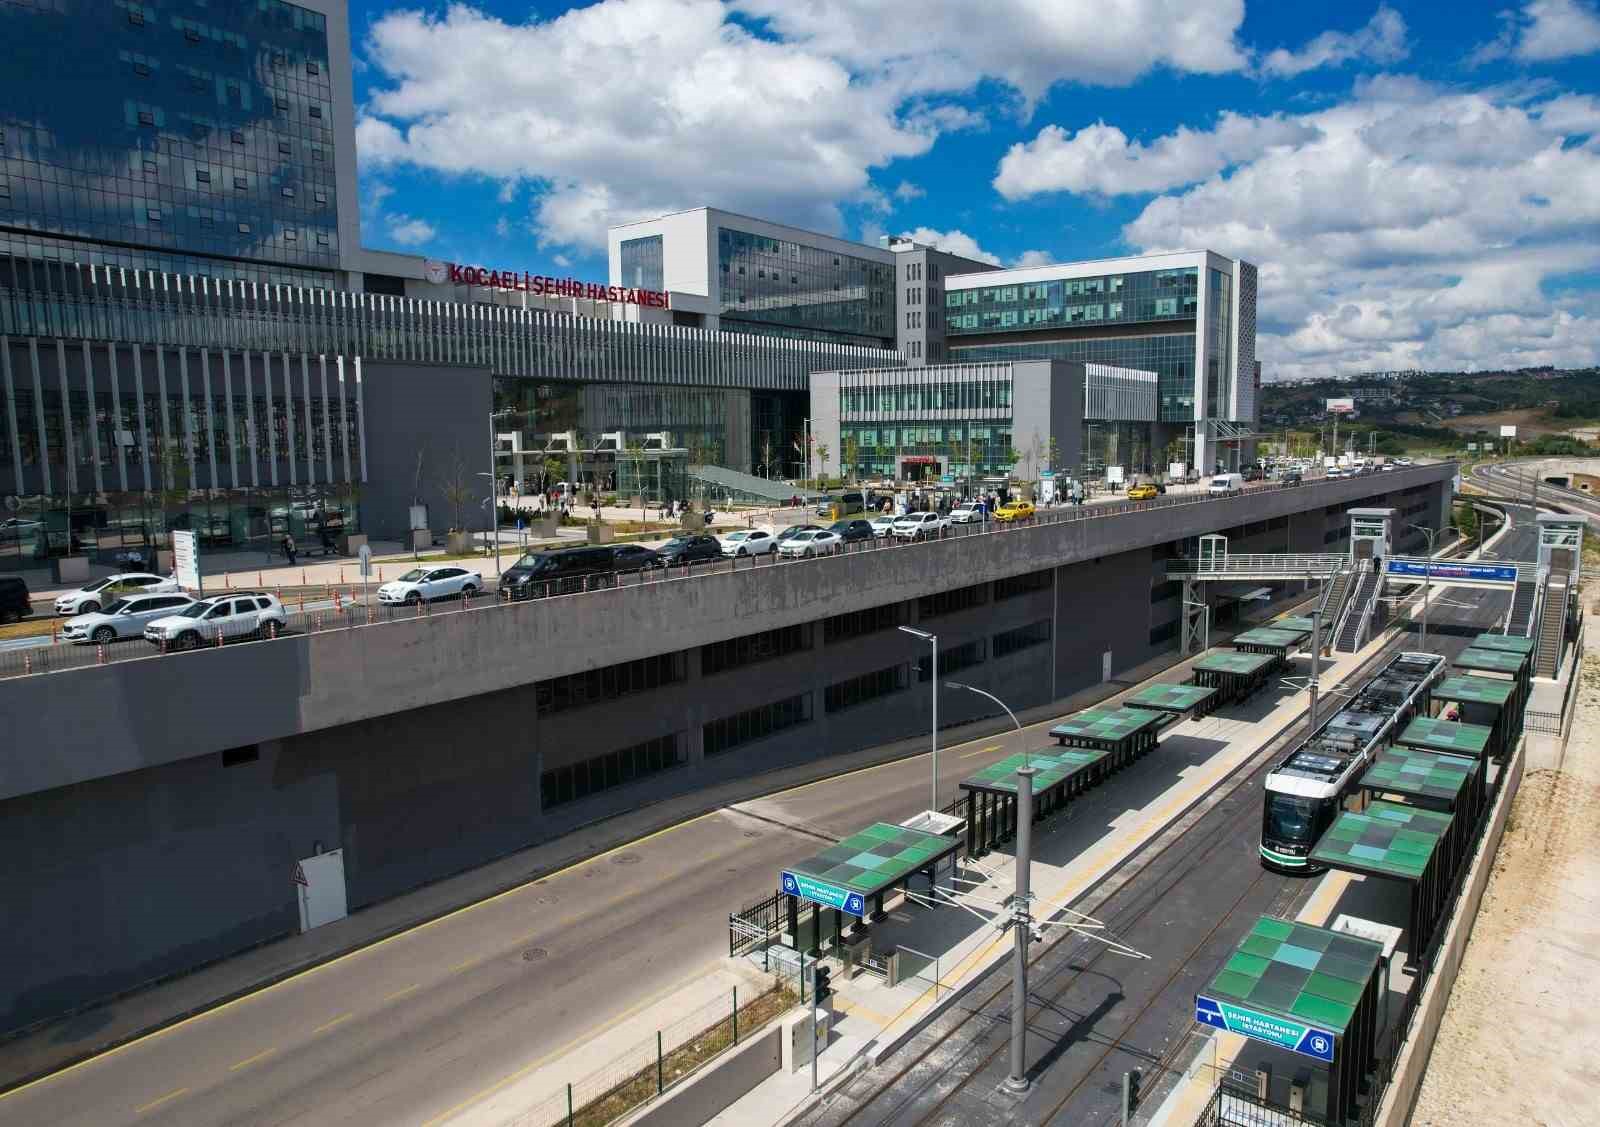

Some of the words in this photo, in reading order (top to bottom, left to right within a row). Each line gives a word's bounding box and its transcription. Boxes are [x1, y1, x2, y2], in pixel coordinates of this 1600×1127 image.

[448, 263, 530, 291] KOCAELİ
[533, 275, 584, 298] ŞEHİR
[587, 283, 669, 309] HASTANESİ
